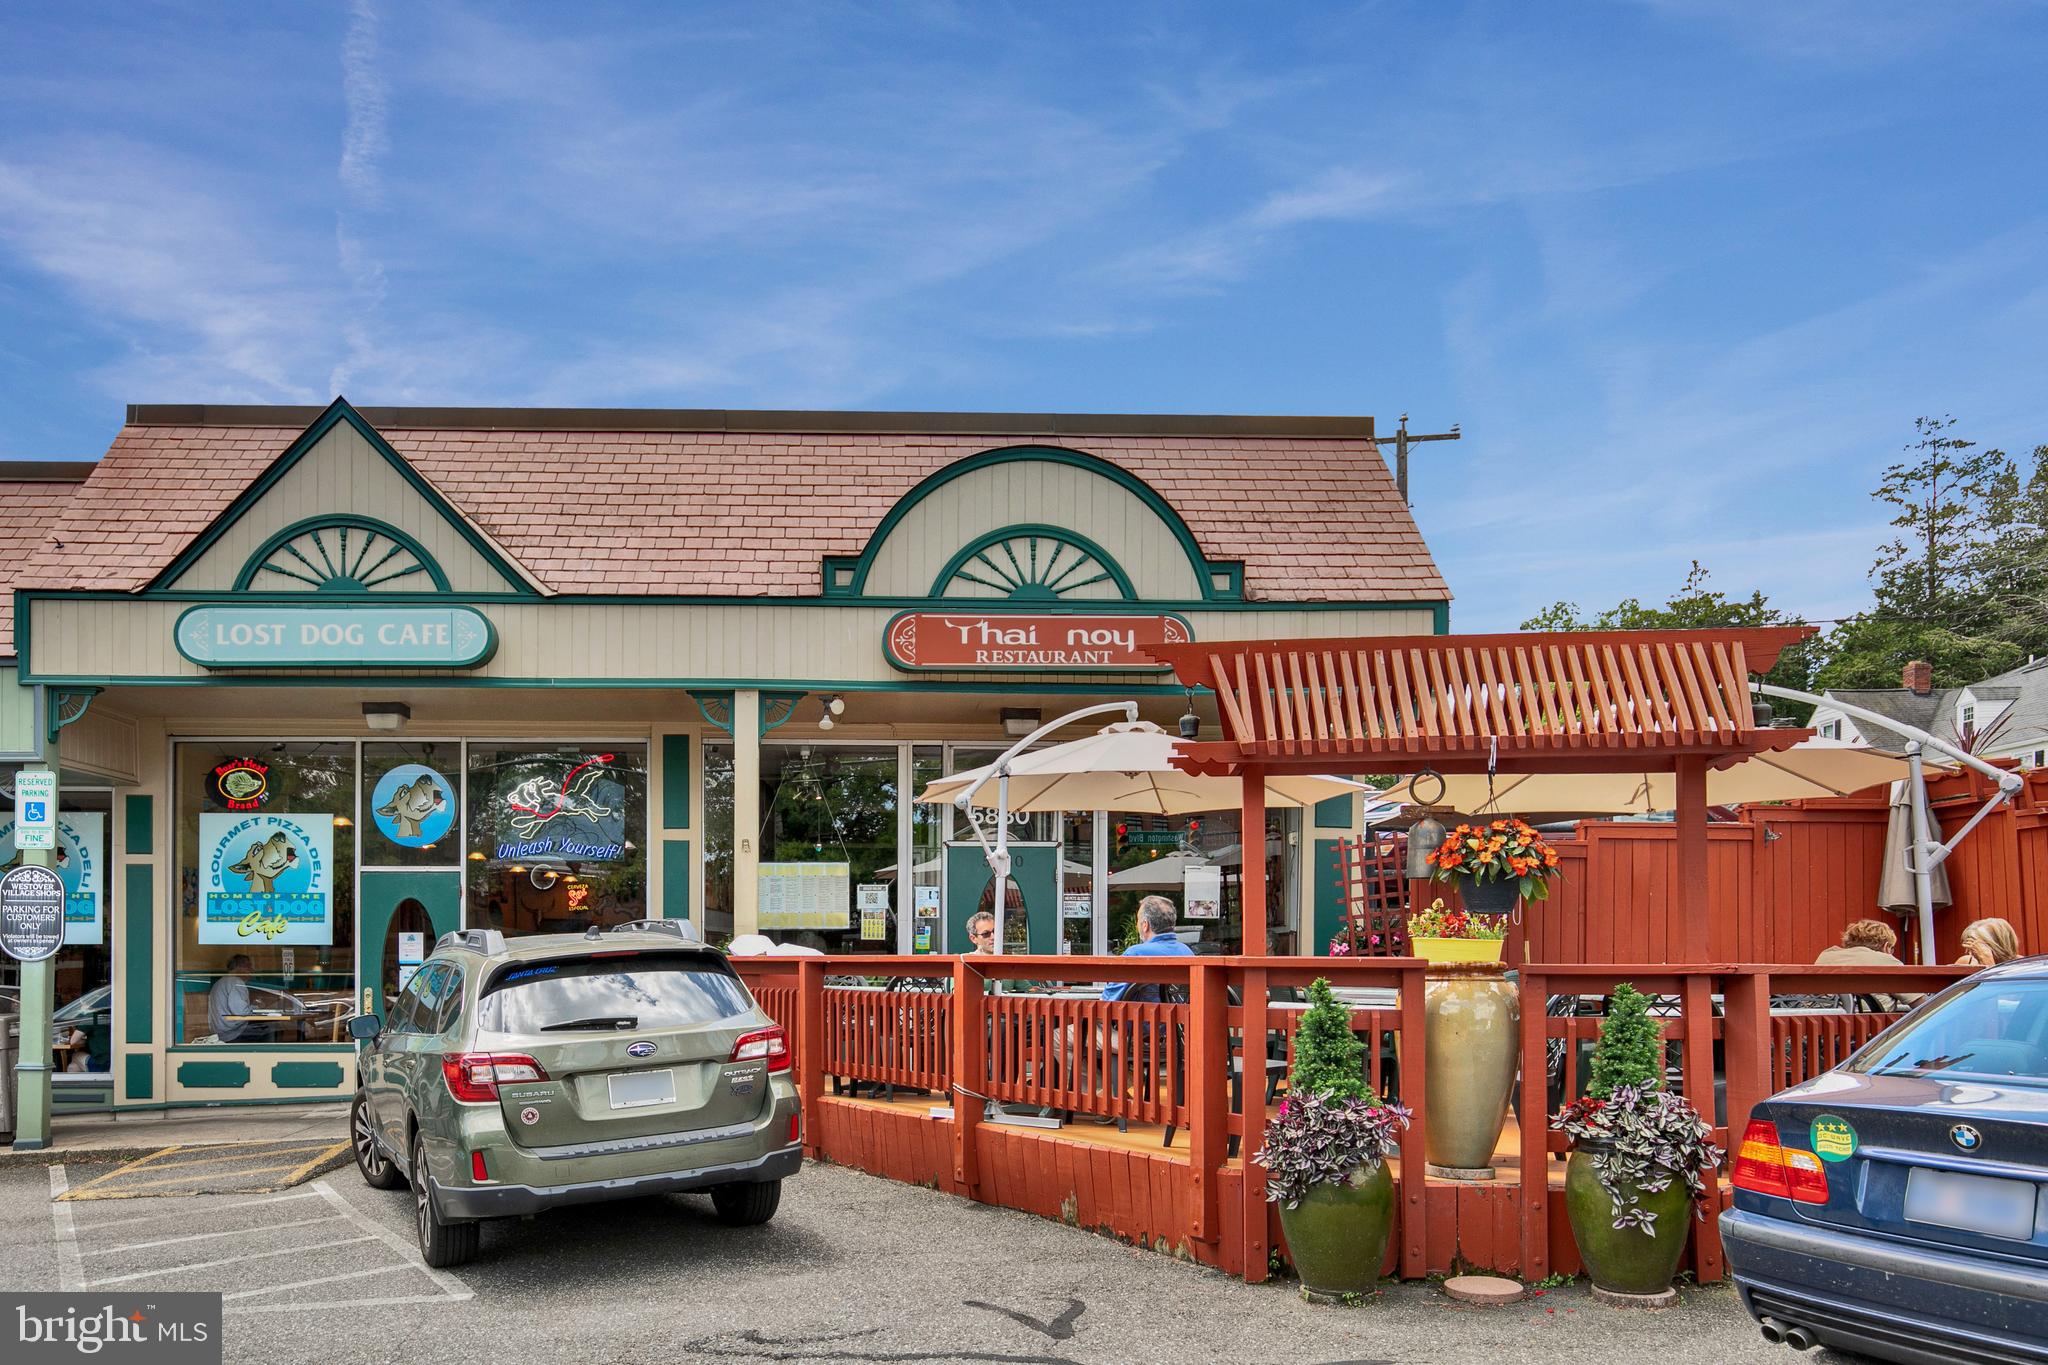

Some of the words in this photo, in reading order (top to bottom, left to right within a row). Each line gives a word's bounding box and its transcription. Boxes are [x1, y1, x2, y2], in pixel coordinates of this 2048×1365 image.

[216, 623, 286, 646] LOST
[301, 623, 365, 646] DOG
[378, 623, 450, 646] CAFE
[944, 618, 1040, 646] Thai
[1067, 629, 1135, 653] noy
[975, 650, 1113, 664] RESTAURANT
[243, 759, 269, 774] Head
[18, 778, 53, 786] RESERVED
[227, 799, 259, 809] Brand
[211, 817, 261, 887] GOURMET
[267, 816, 310, 846] PIZZA
[307, 847, 322, 888] DELI
[498, 836, 553, 859] Unleash
[560, 837, 622, 859] Yourself!
[80, 846, 92, 888] DELI
[2, 889, 35, 897] VILLAGE
[2, 905, 41, 913] PARKING
[65, 900, 95, 915] OG
[208, 900, 268, 915] LOST
[274, 900, 324, 915] DOG
[20, 922, 42, 930] ONLY
[724, 1067, 762, 1076] OUTBACK
[511, 1090, 555, 1098] SUBARU
